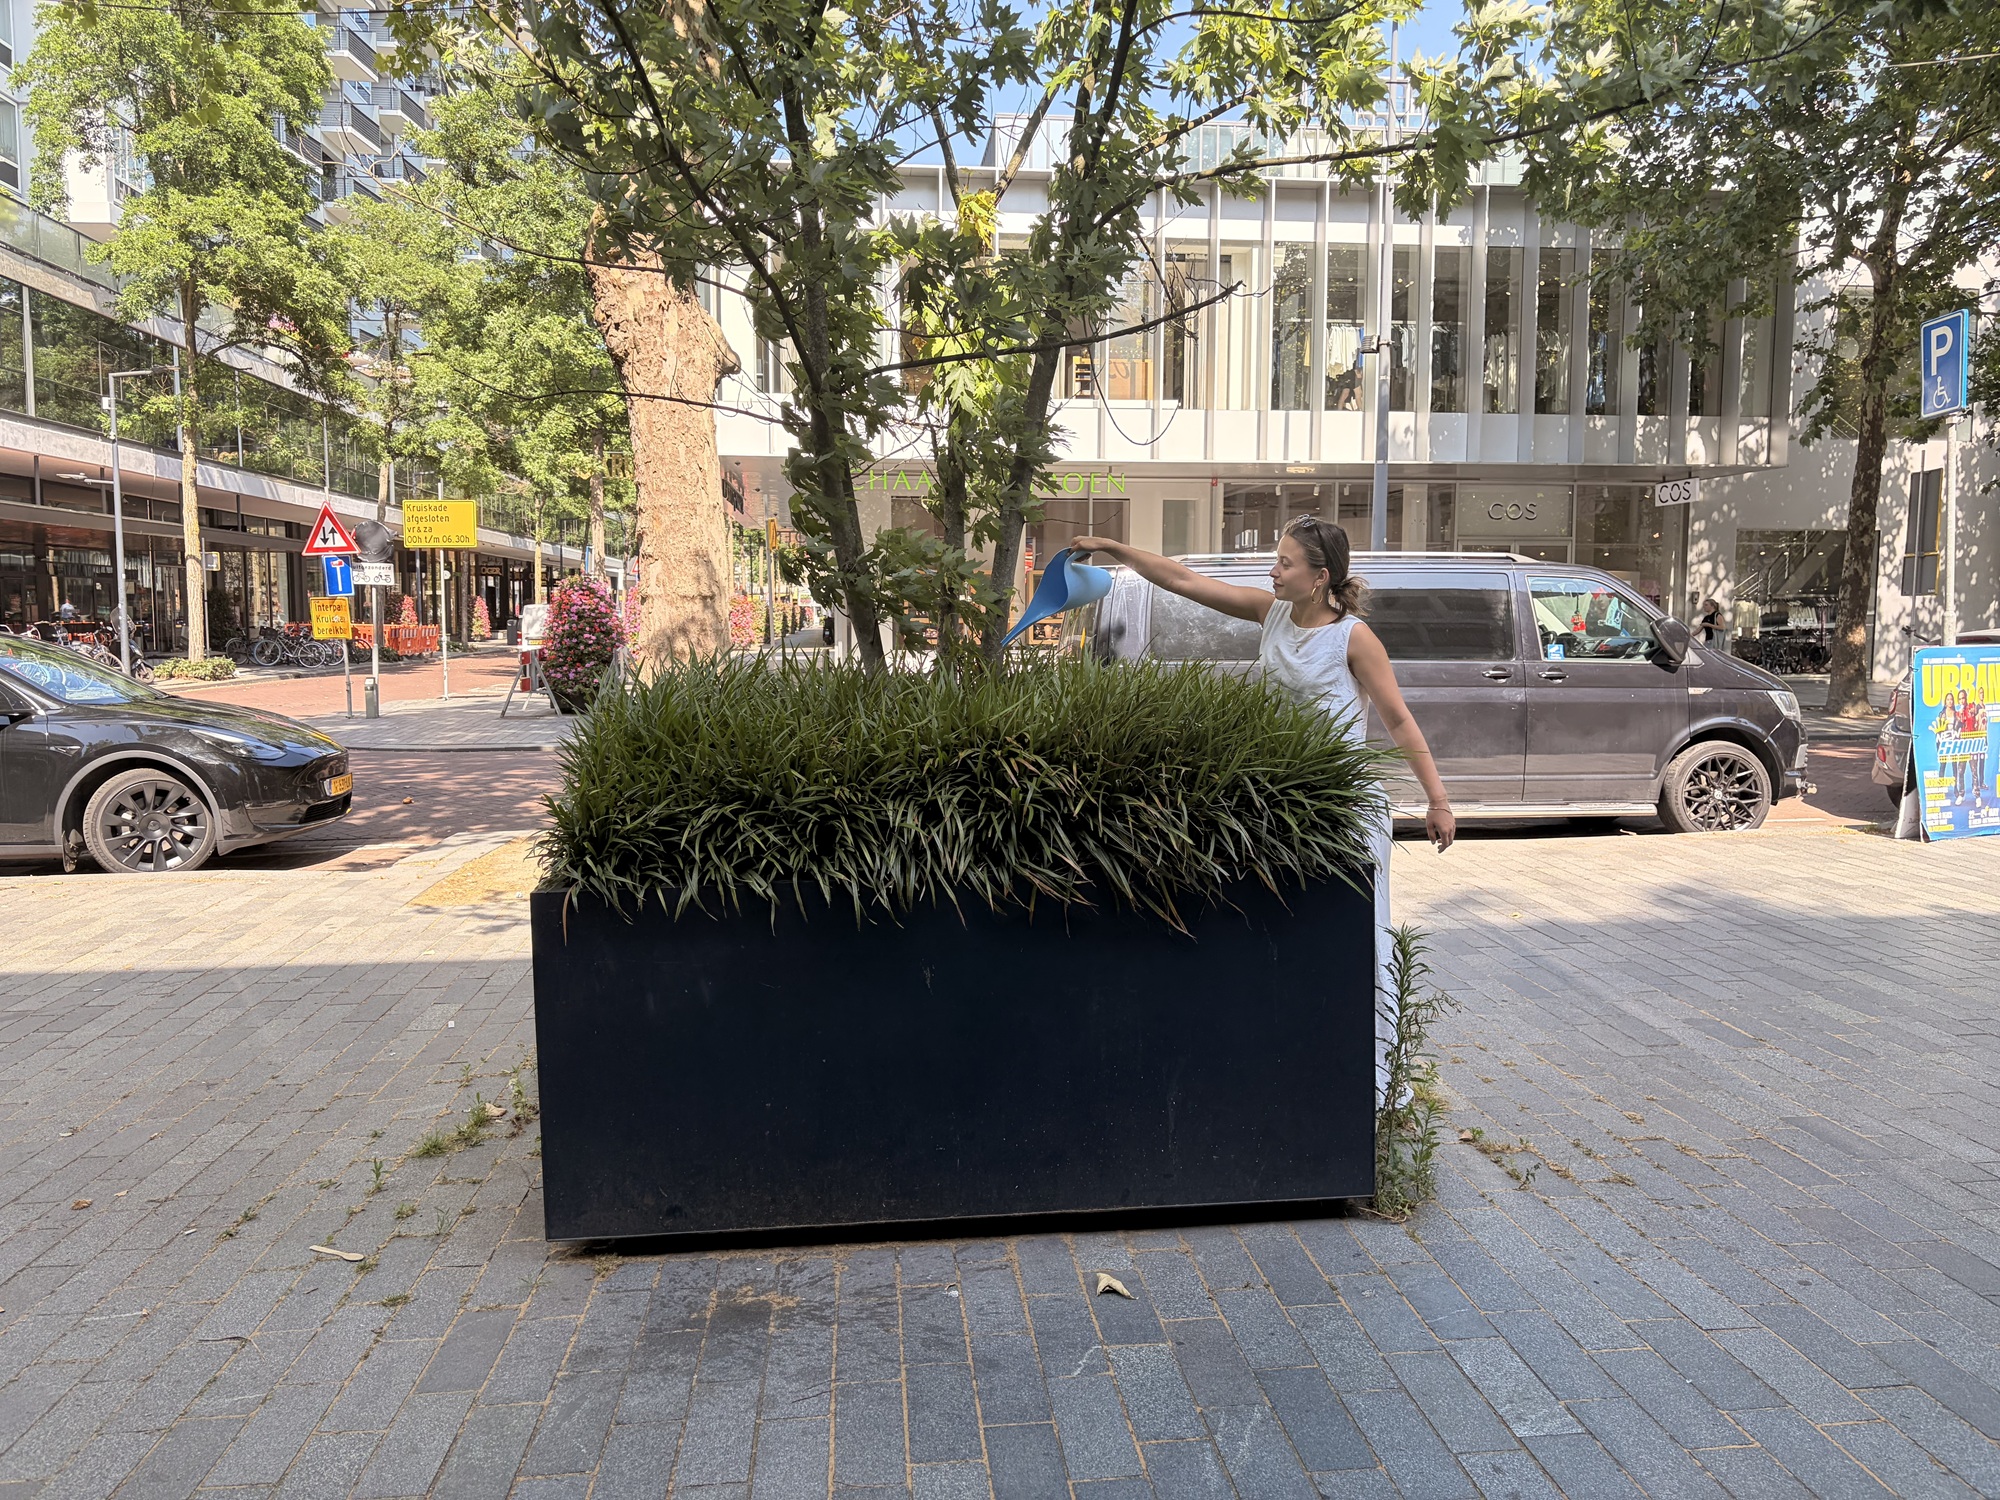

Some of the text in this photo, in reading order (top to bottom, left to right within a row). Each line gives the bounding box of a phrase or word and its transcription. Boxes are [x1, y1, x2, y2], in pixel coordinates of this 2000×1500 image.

[1930, 325, 1954, 377] P
[1657, 481, 1692, 504] COS
[406, 504, 448, 512] Kruiskade
[1487, 503, 1538, 521] COS
[406, 514, 450, 525] afgesloten
[424, 535, 440, 544] t/m
[442, 535, 470, 543] 06.30h
[1935, 728, 1962, 744] NEW
